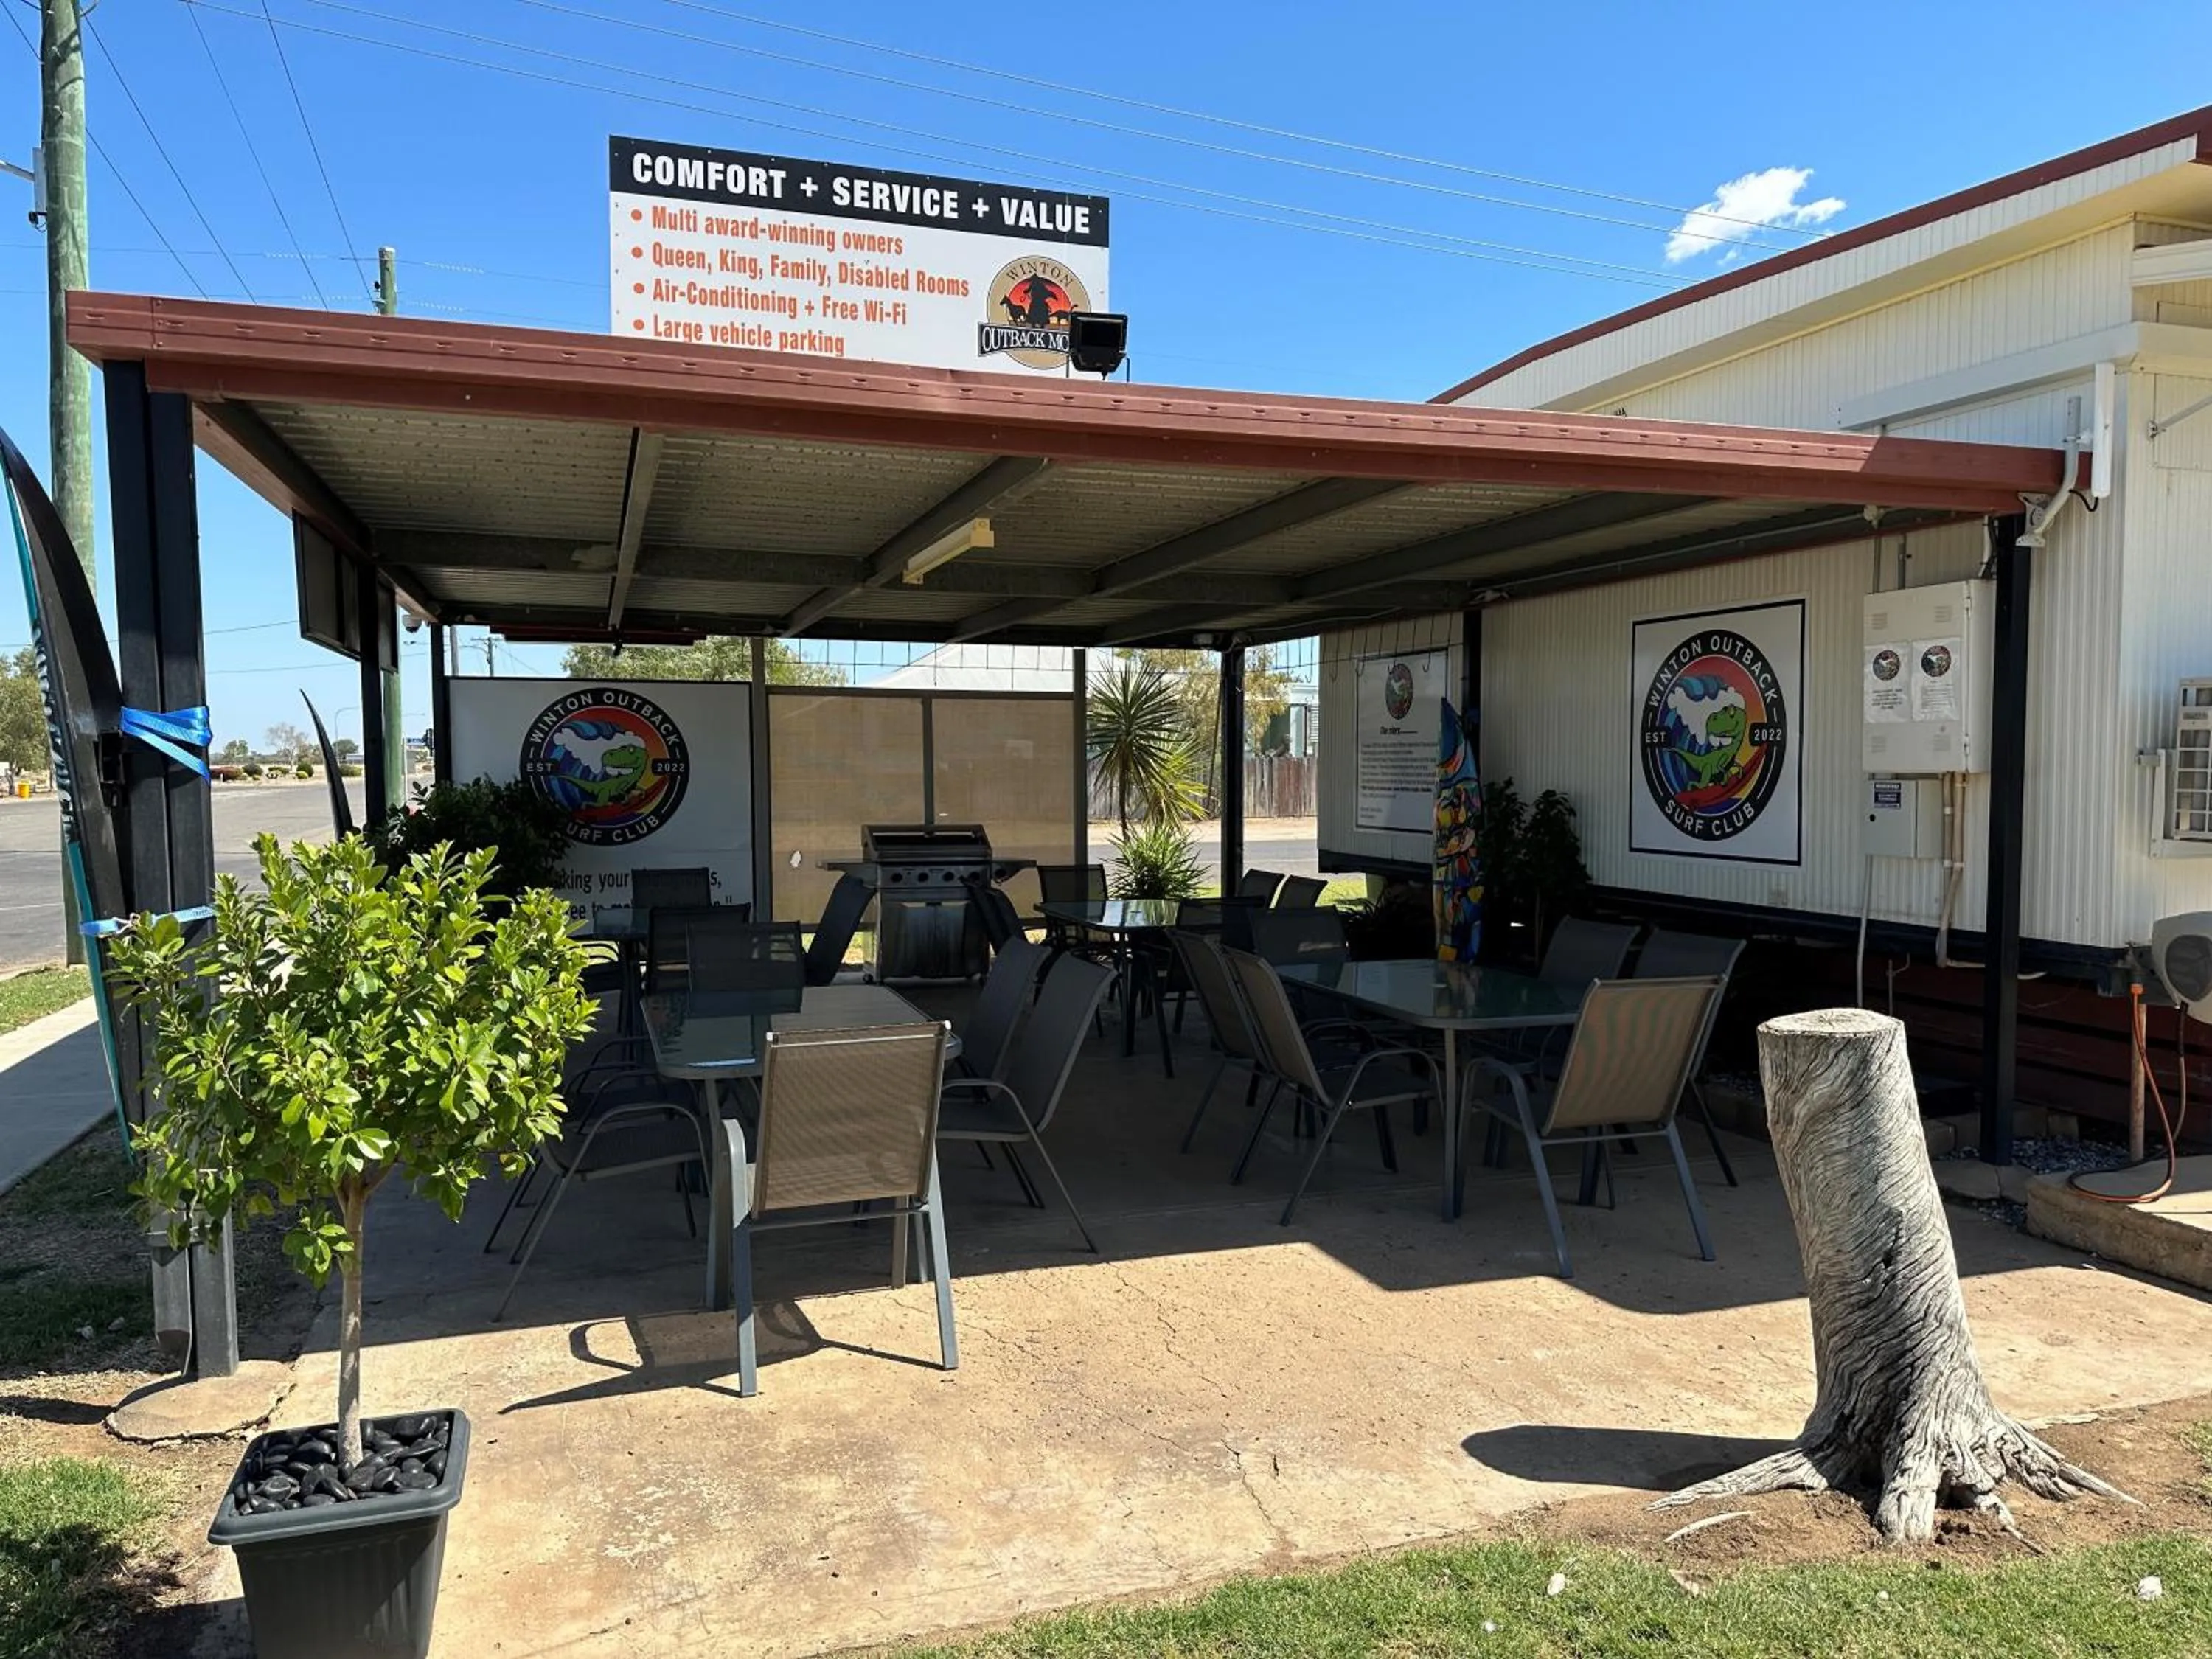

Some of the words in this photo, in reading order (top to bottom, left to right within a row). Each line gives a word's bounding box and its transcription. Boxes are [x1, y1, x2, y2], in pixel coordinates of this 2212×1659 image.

[633, 153, 786, 198] COMFORT
[800, 176, 818, 197] +
[832, 176, 958, 219] SERVICE
[972, 198, 990, 218] +
[1001, 197, 1090, 234] VALUE
[652, 206, 697, 232] Multi
[705, 217, 835, 252] award-winning
[843, 233, 903, 255] owners
[652, 241, 712, 274] Queen,
[720, 248, 763, 279] King,
[771, 254, 831, 286] Family,
[838, 262, 909, 291] Disabled
[917, 270, 970, 296] Rooms
[1006, 262, 1073, 287] WINTON
[653, 278, 797, 319] Air-Conditioning
[805, 300, 814, 316] +
[822, 295, 858, 321] Free
[864, 299, 906, 325] Wi-Fi
[653, 313, 703, 342] Large
[710, 321, 772, 347] vehicle
[779, 329, 844, 357] parking
[982, 327, 1045, 352] OUTBACK
[1649, 639, 1701, 707] WINTON
[1711, 635, 1778, 703] OUTBACK
[530, 692, 593, 743] WINTON
[603, 692, 680, 745] OUTBACK
[1645, 732, 1667, 742] EST
[1754, 729, 1782, 741] 2022
[526, 762, 553, 772] EST
[656, 762, 685, 772] 2022
[566, 821, 602, 843] URF
[612, 815, 658, 841] CLUB
[1666, 800, 1703, 833] SURF
[1711, 804, 1755, 835] CLUB
[561, 867, 592, 894] king
[598, 872, 630, 894] your
